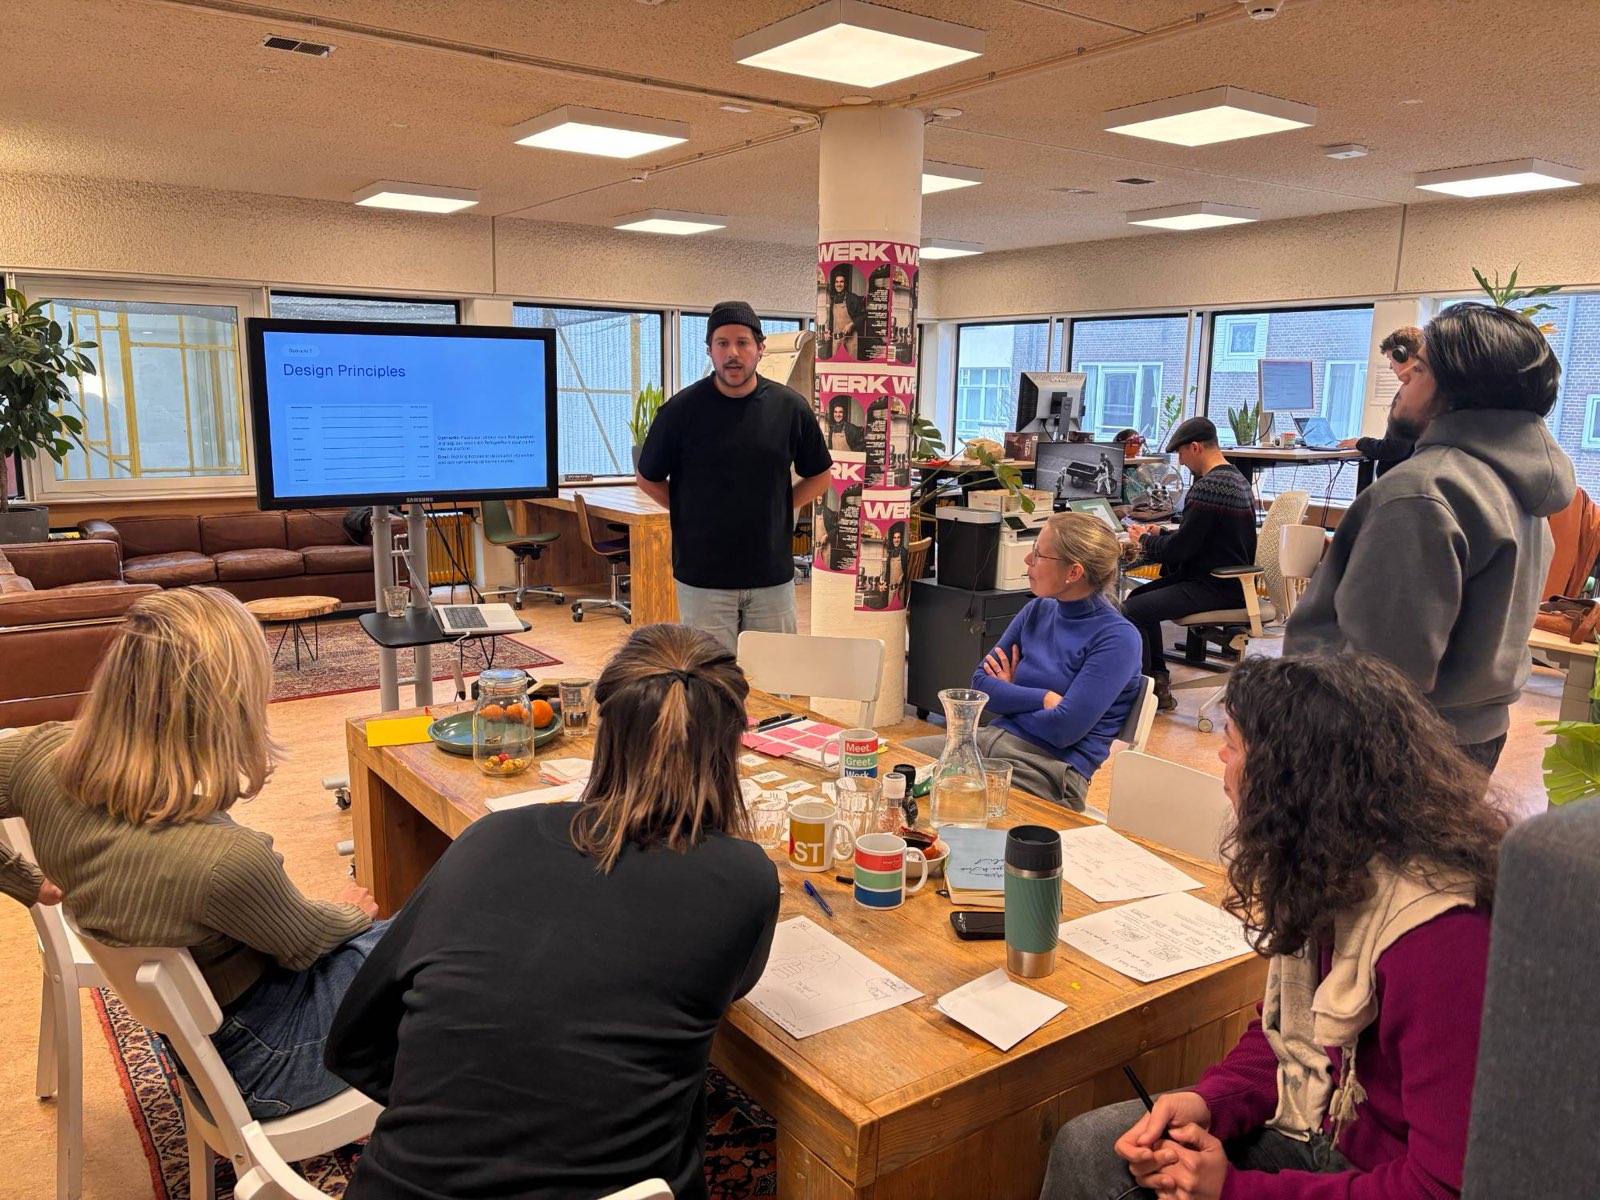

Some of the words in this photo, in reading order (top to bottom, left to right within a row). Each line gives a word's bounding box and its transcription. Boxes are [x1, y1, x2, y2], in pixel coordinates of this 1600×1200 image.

[819, 242, 891, 263] WERK
[283, 363, 334, 379] Design
[338, 364, 406, 379] Principles
[846, 743, 872, 753] Meet.
[845, 756, 873, 767] Greet.
[794, 841, 823, 864] ST
